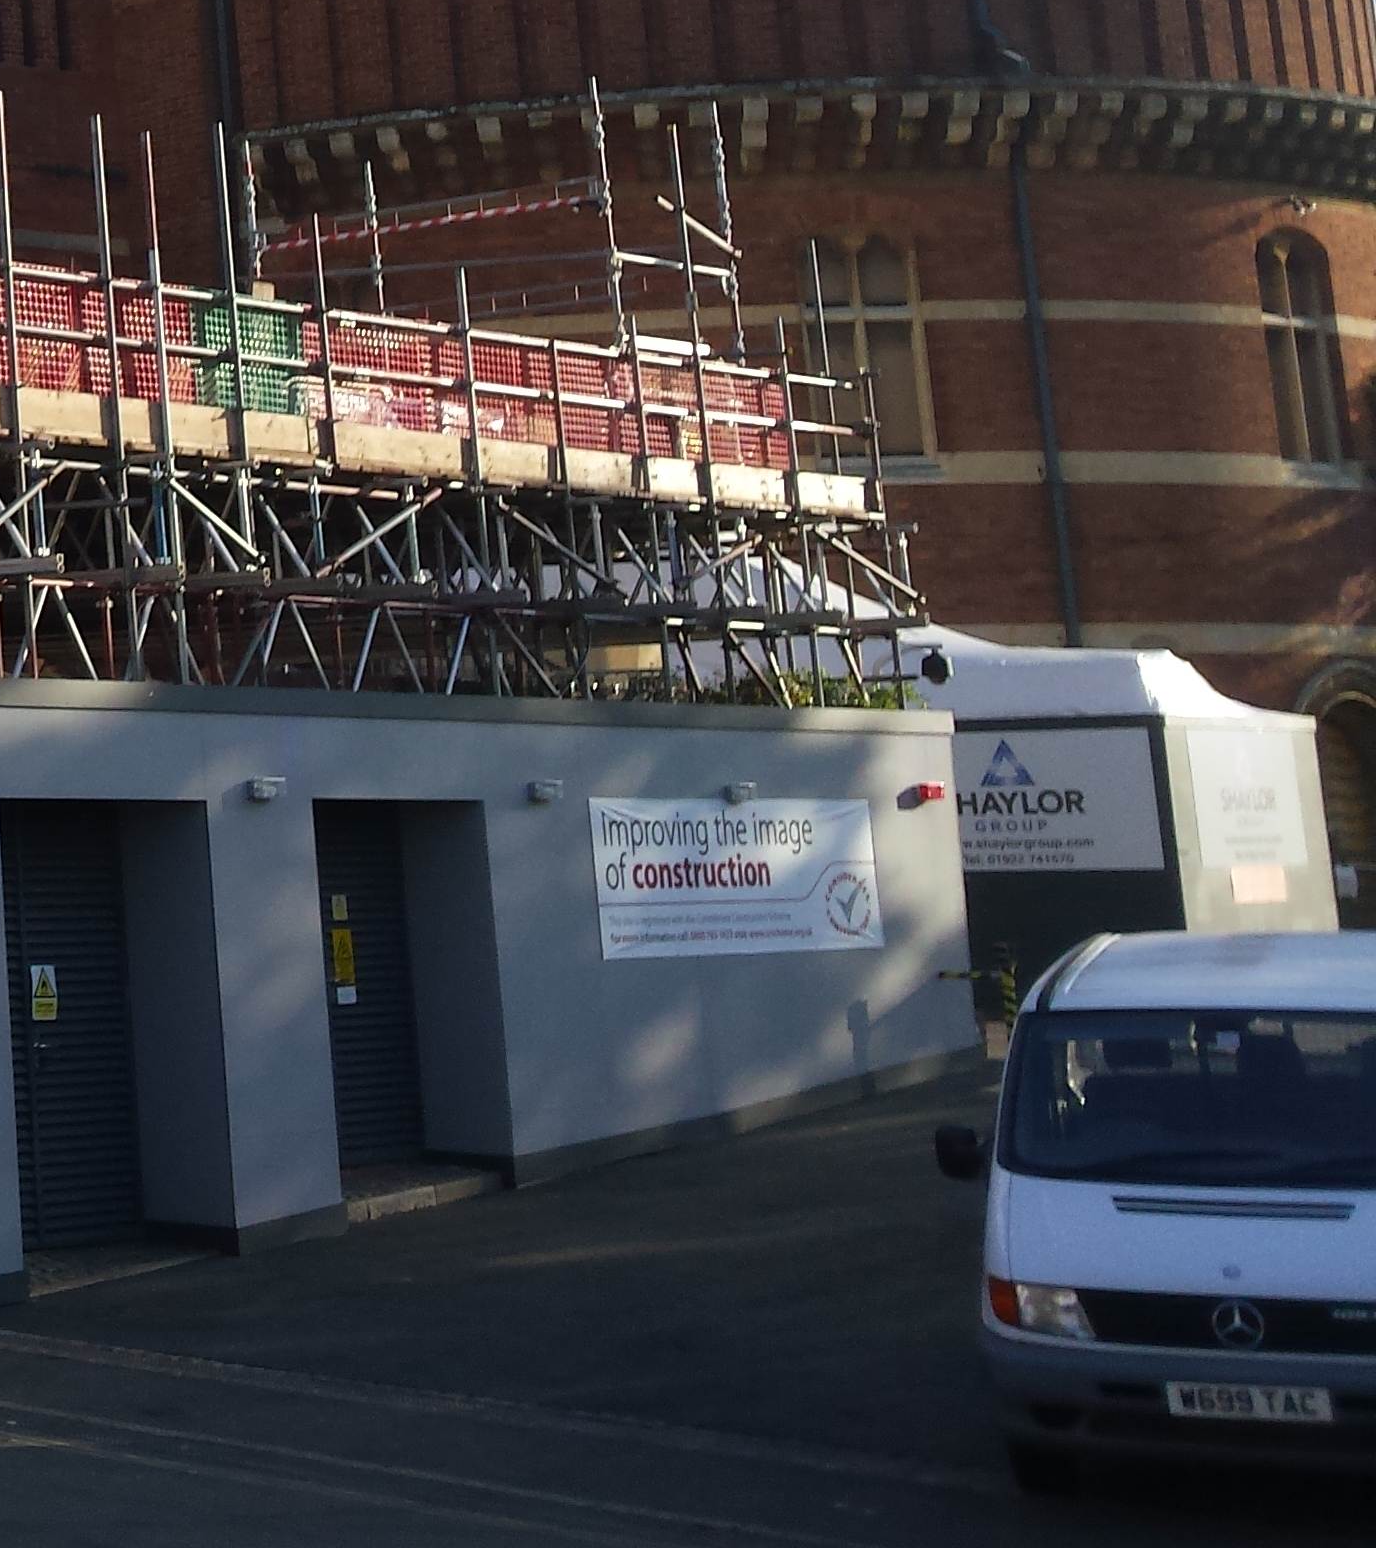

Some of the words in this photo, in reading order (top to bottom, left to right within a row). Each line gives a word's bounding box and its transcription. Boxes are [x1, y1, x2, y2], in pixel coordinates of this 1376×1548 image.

[601, 811, 710, 856] Improving
[714, 809, 748, 845] the
[752, 812, 814, 854] image
[605, 852, 627, 890] of
[632, 854, 772, 889] construction
